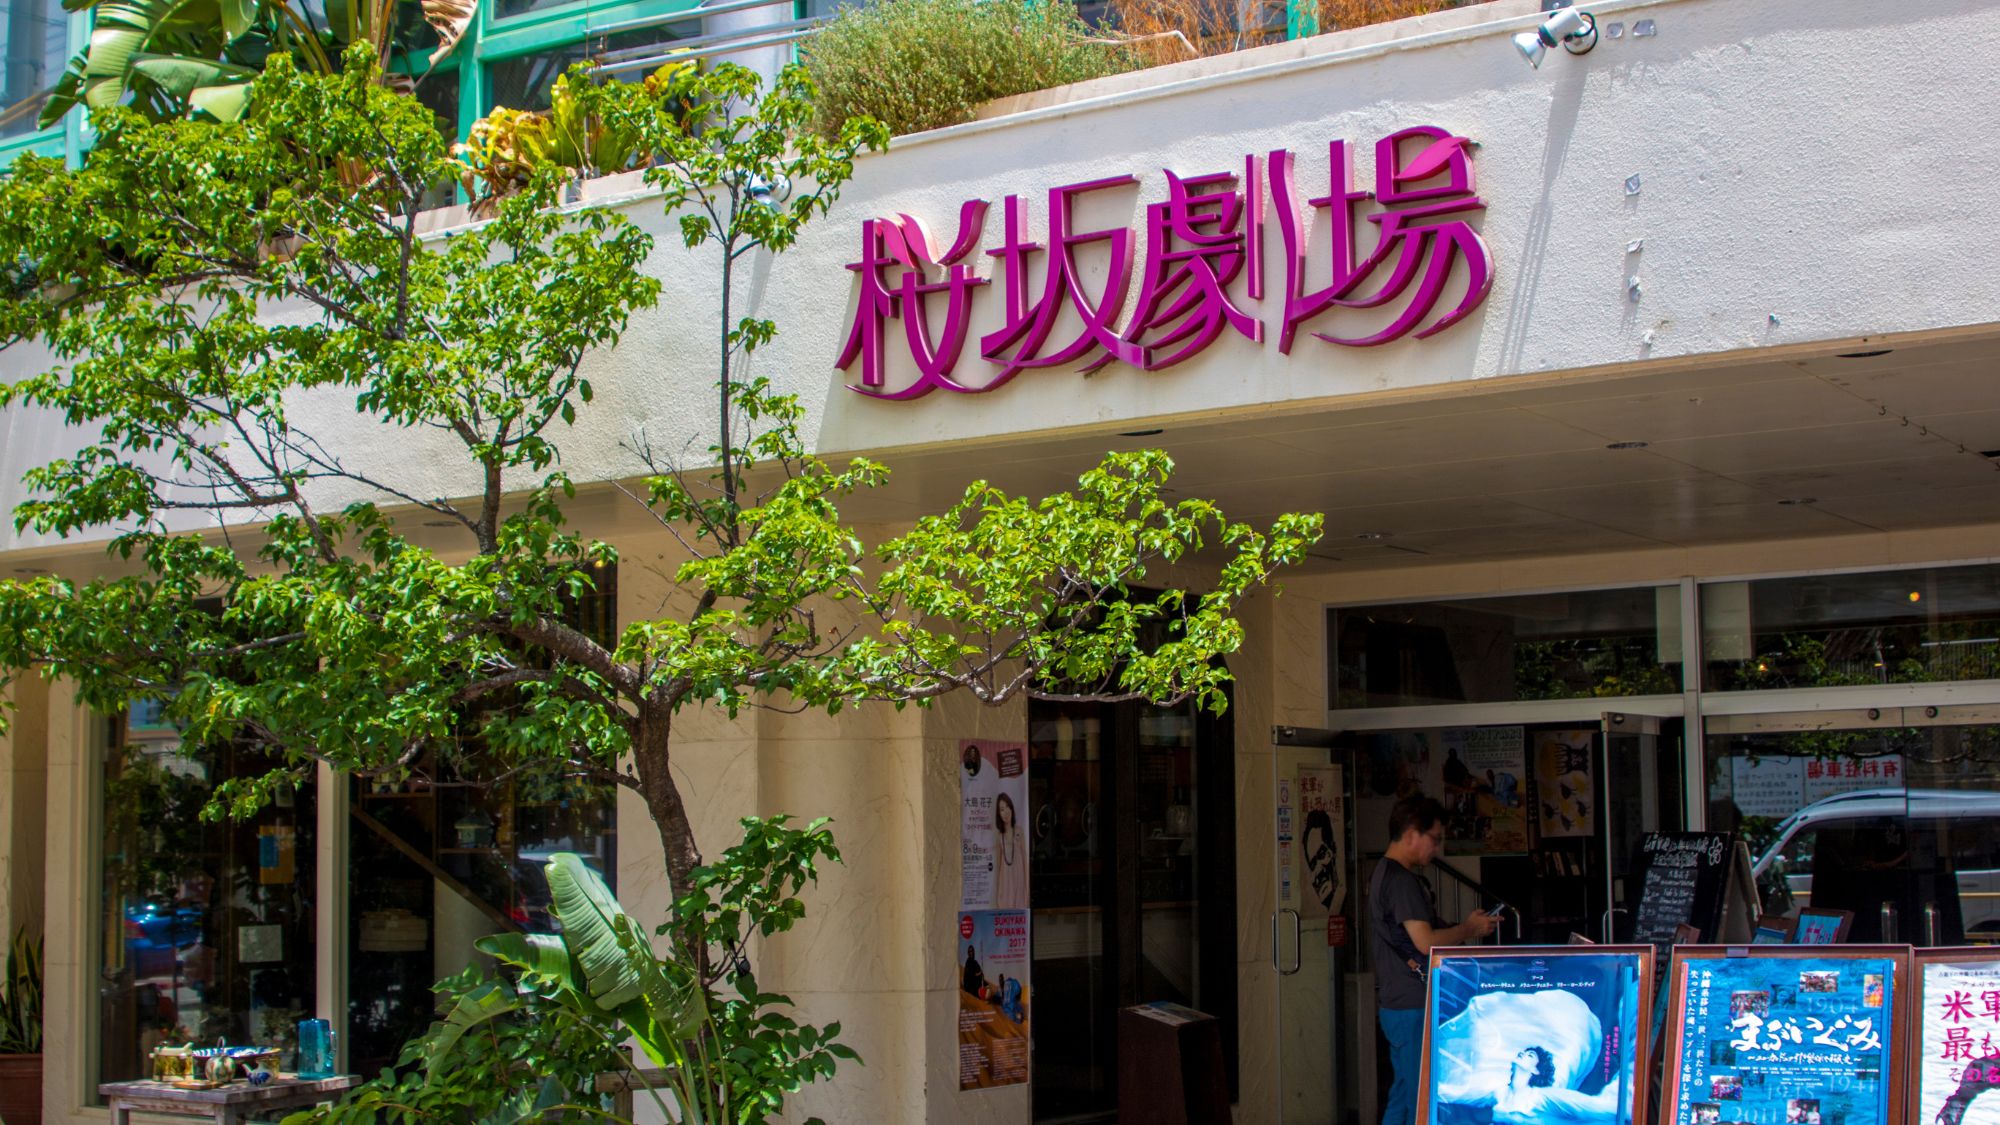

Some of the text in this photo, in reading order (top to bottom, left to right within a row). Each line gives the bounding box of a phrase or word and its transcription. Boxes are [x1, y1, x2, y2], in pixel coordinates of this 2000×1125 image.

[835, 125, 1494, 400] 桜坂劇場
[994, 916, 1026, 926] SUKIYAKI
[994, 927, 1026, 937] OKINAWA
[1009, 938, 1026, 948] 2017
